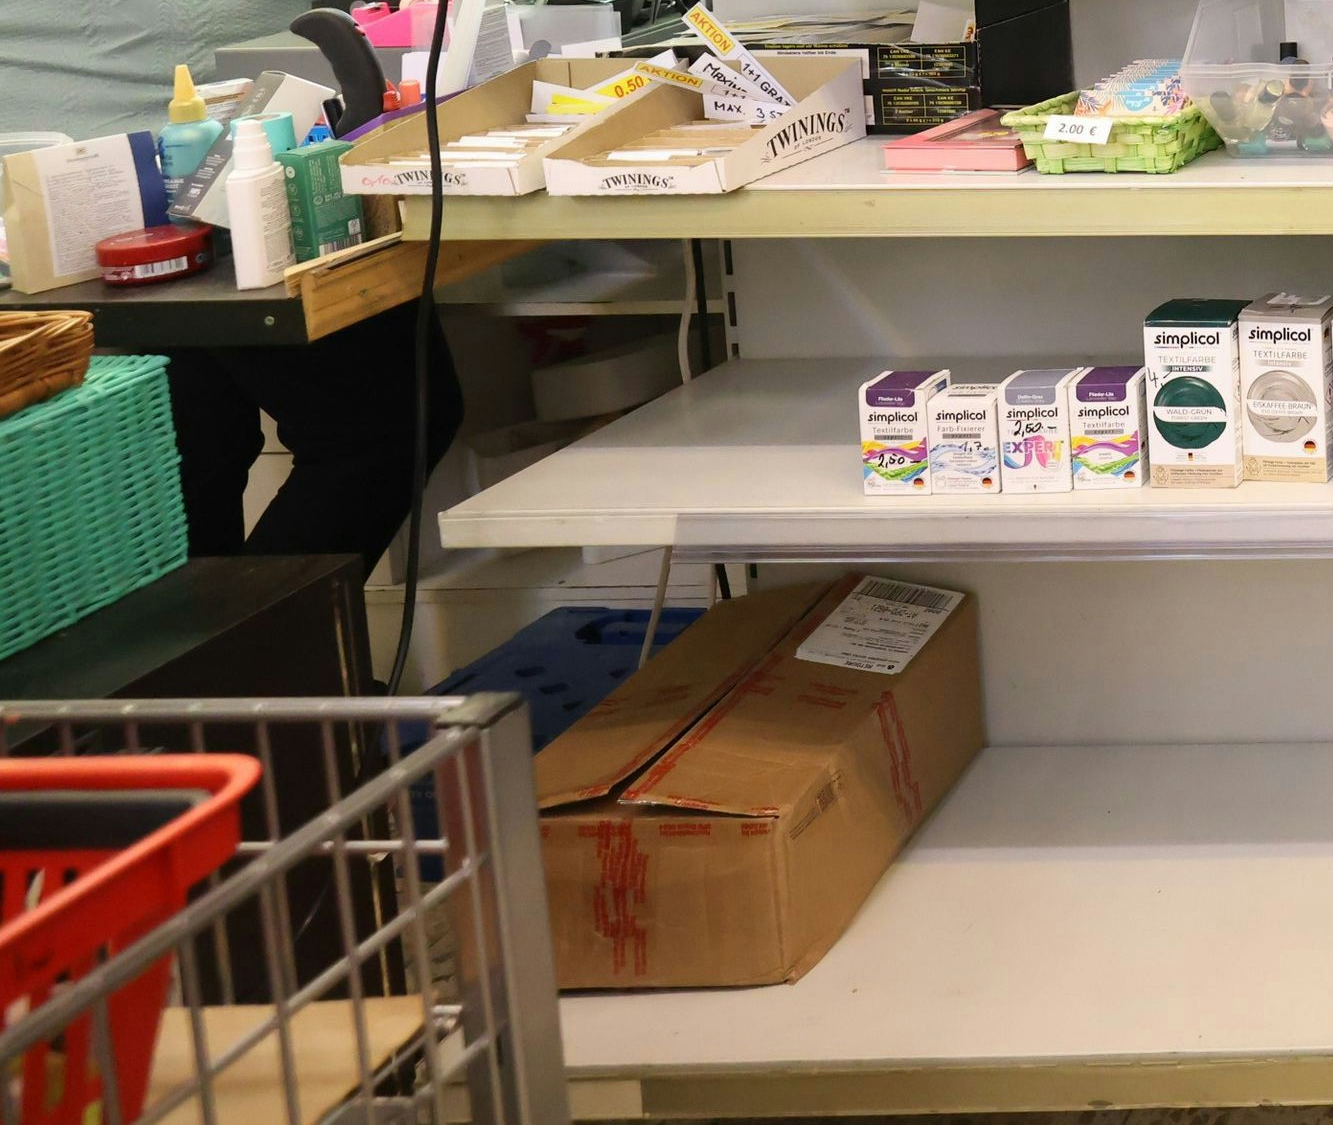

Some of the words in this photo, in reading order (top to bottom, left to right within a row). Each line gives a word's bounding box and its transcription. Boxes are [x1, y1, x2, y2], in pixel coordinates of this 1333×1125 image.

[691, 9, 733, 54] AKTION
[639, 64, 700, 87] AKTION
[613, 74, 646, 100] 0.50
[756, 107, 766, 120] 3
[763, 111, 846, 158] TWININGS
[1058, 122, 1084, 135] 2.00
[604, 173, 673, 189] TWININGS
[1154, 331, 1221, 349] simplicol
[1249, 326, 1312, 344] simplicol
[1158, 355, 1217, 364] TEXTILFARBE
[1253, 350, 1308, 360] TEXTILFARBE
[1171, 365, 1204, 373] INTENSIV
[867, 411, 920, 426] simplicol
[935, 409, 988, 424] simplicol
[1006, 407, 1059, 420] simplicol
[1077, 405, 1130, 420] simplicol
[1166, 408, 1213, 416] WALD-GRÜN
[872, 425, 915, 435] Textilfarbe
[936, 425, 986, 434] Farb-Fixierer
[1083, 421, 1126, 429] Textilfarbe
